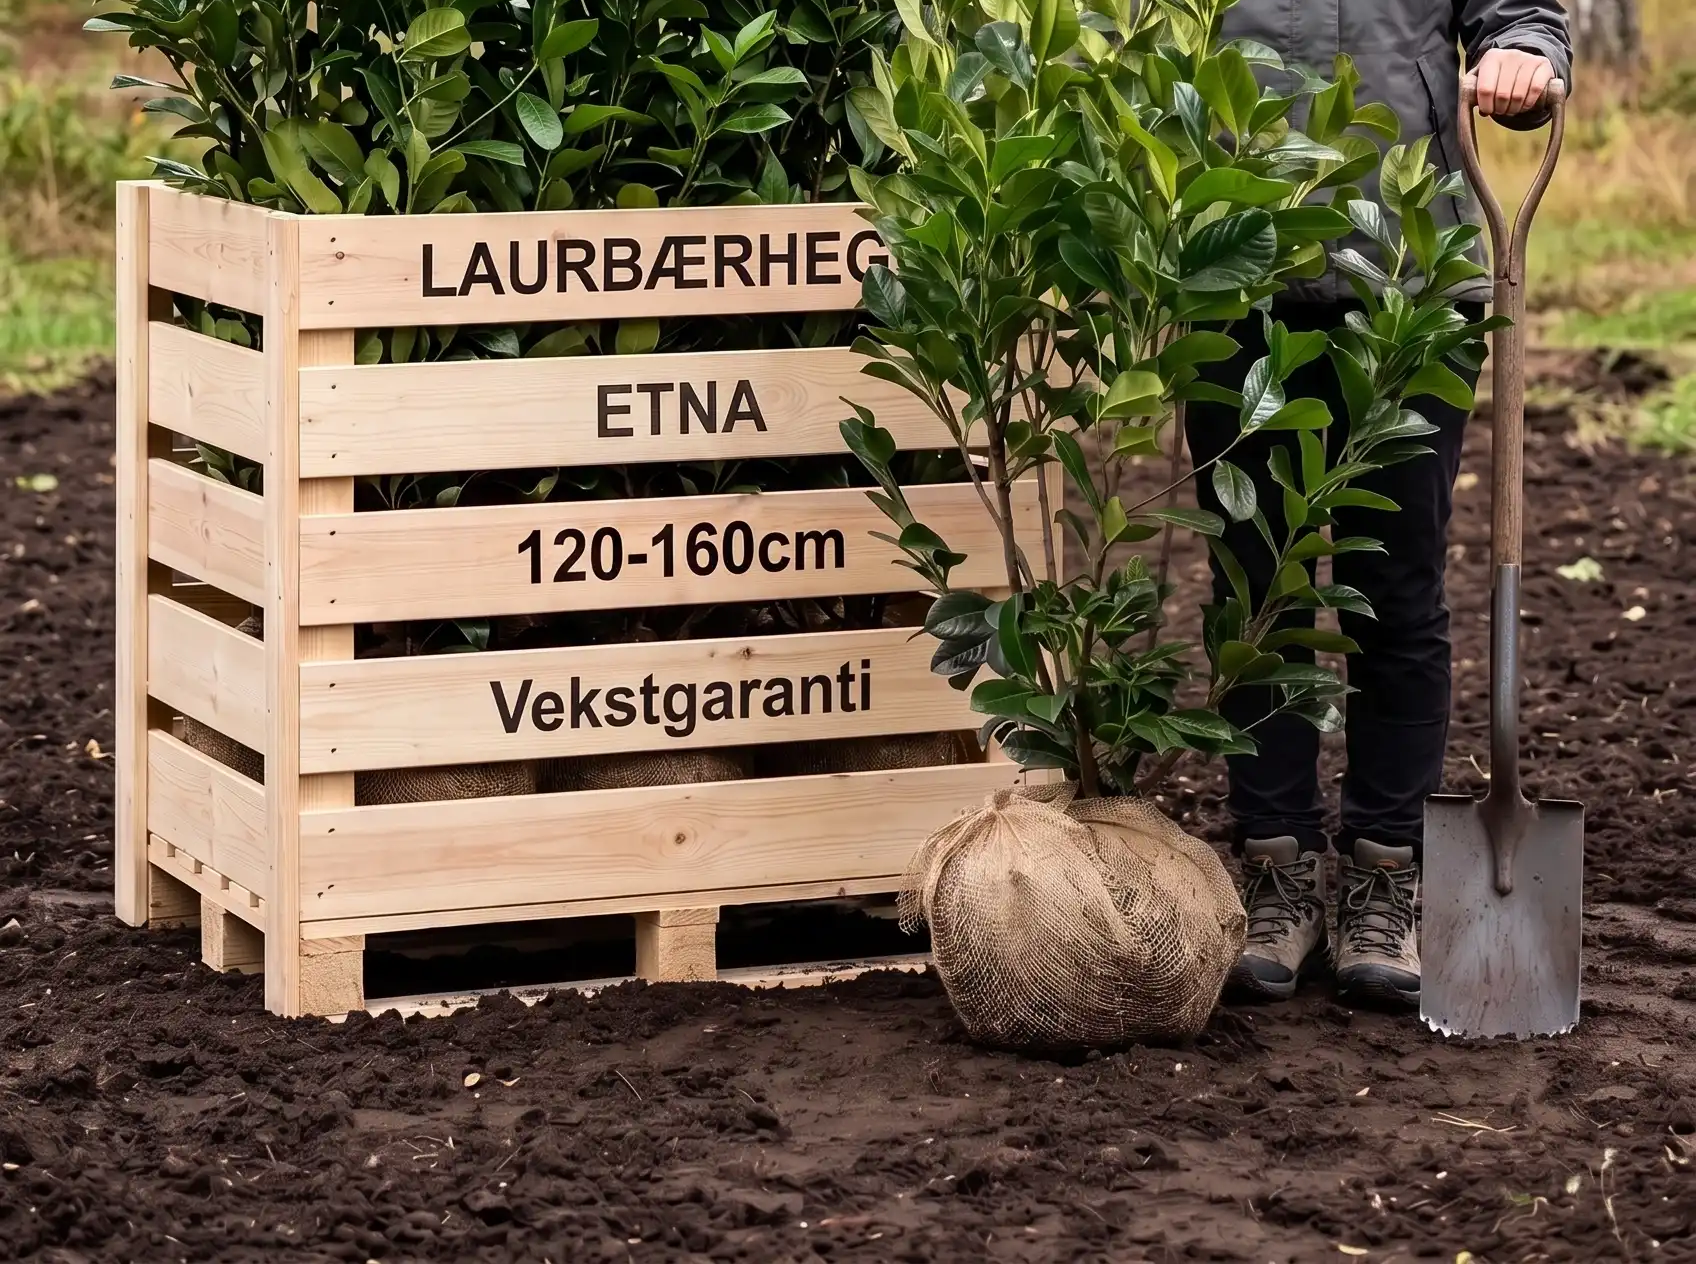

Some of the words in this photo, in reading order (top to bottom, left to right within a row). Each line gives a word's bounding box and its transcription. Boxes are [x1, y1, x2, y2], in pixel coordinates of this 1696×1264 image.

[597, 379, 768, 438] ETNA
[517, 520, 846, 585] 120-160cm
[489, 658, 873, 738] Vekstgaranti
